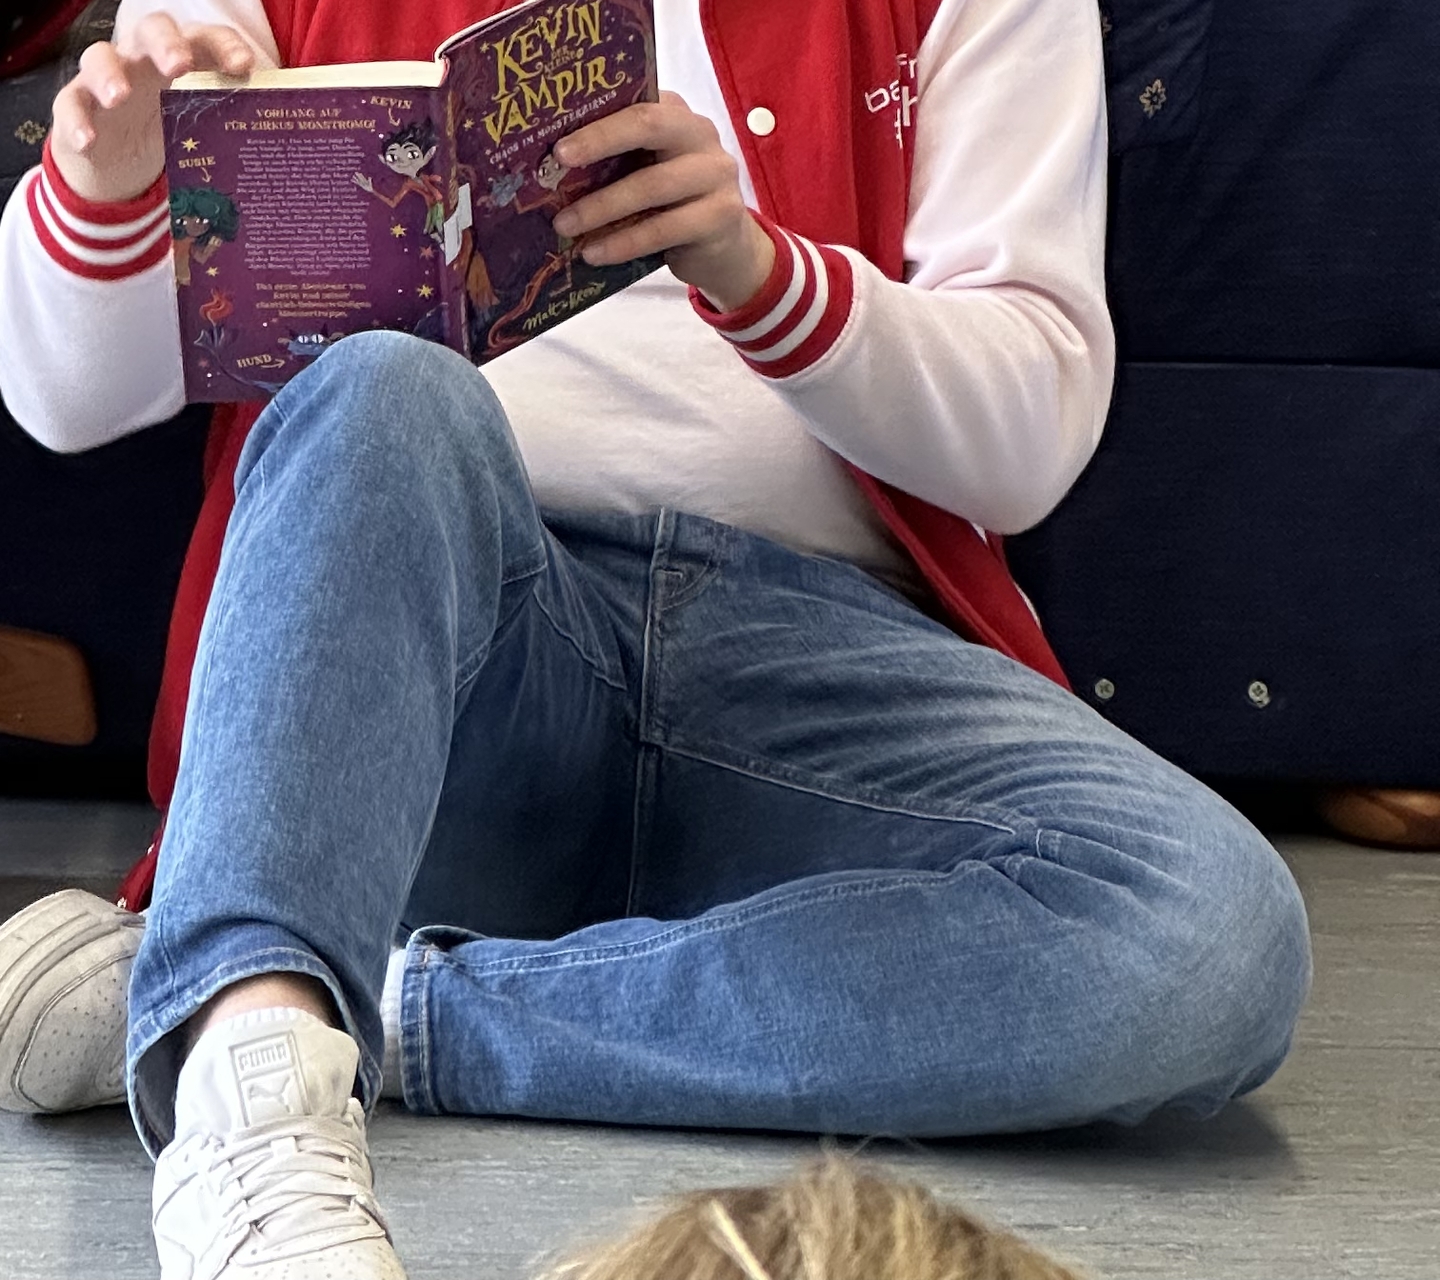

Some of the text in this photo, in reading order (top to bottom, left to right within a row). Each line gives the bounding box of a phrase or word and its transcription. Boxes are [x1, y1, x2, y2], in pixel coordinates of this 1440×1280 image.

[370, 95, 412, 109] KEVIN
[481, 56, 626, 148] VAMPIR
[489, 142, 519, 165] CHAOS
[178, 156, 216, 169] SUSIE
[236, 354, 272, 368] HUND
